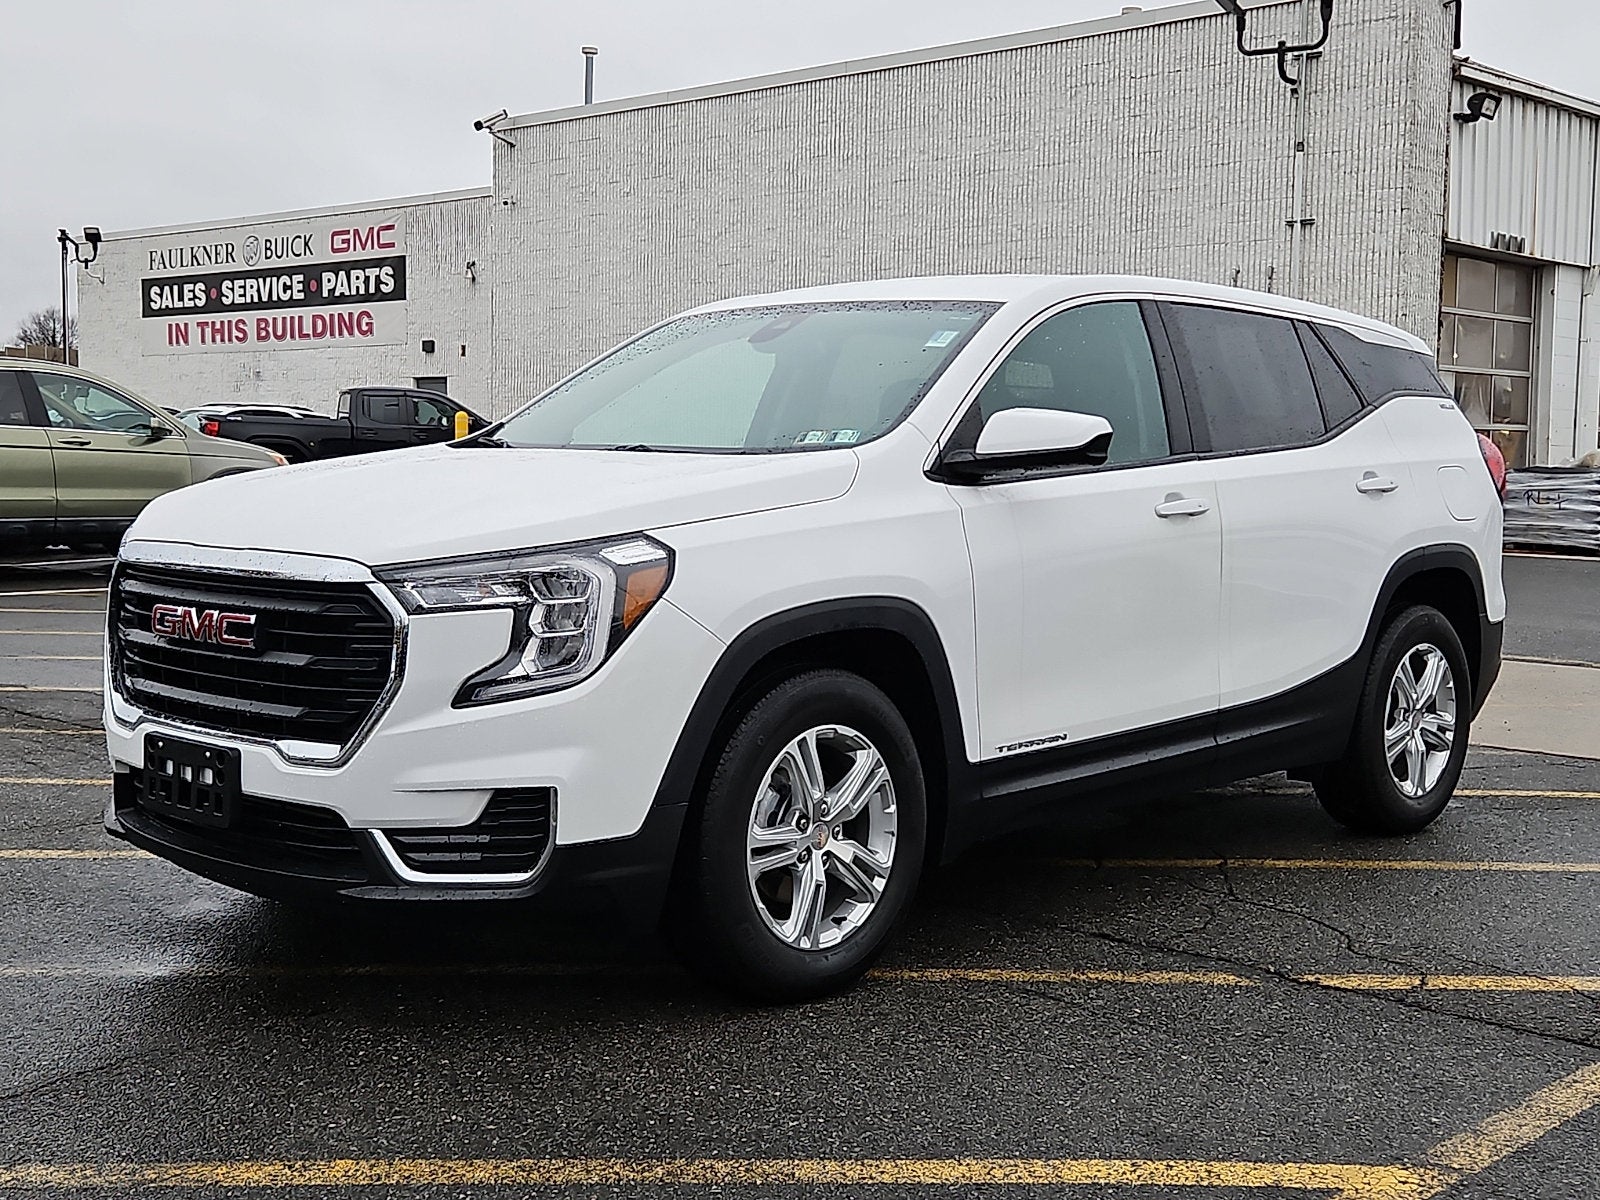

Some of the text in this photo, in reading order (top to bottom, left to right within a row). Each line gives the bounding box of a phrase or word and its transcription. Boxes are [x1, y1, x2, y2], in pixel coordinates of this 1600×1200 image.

[148, 224, 396, 271] FAULKNER BUICK GMC
[150, 266, 395, 310] SALES SERVICE PARTS
[167, 310, 375, 346] IN THIS BUILDING
[152, 604, 257, 649] GMC
